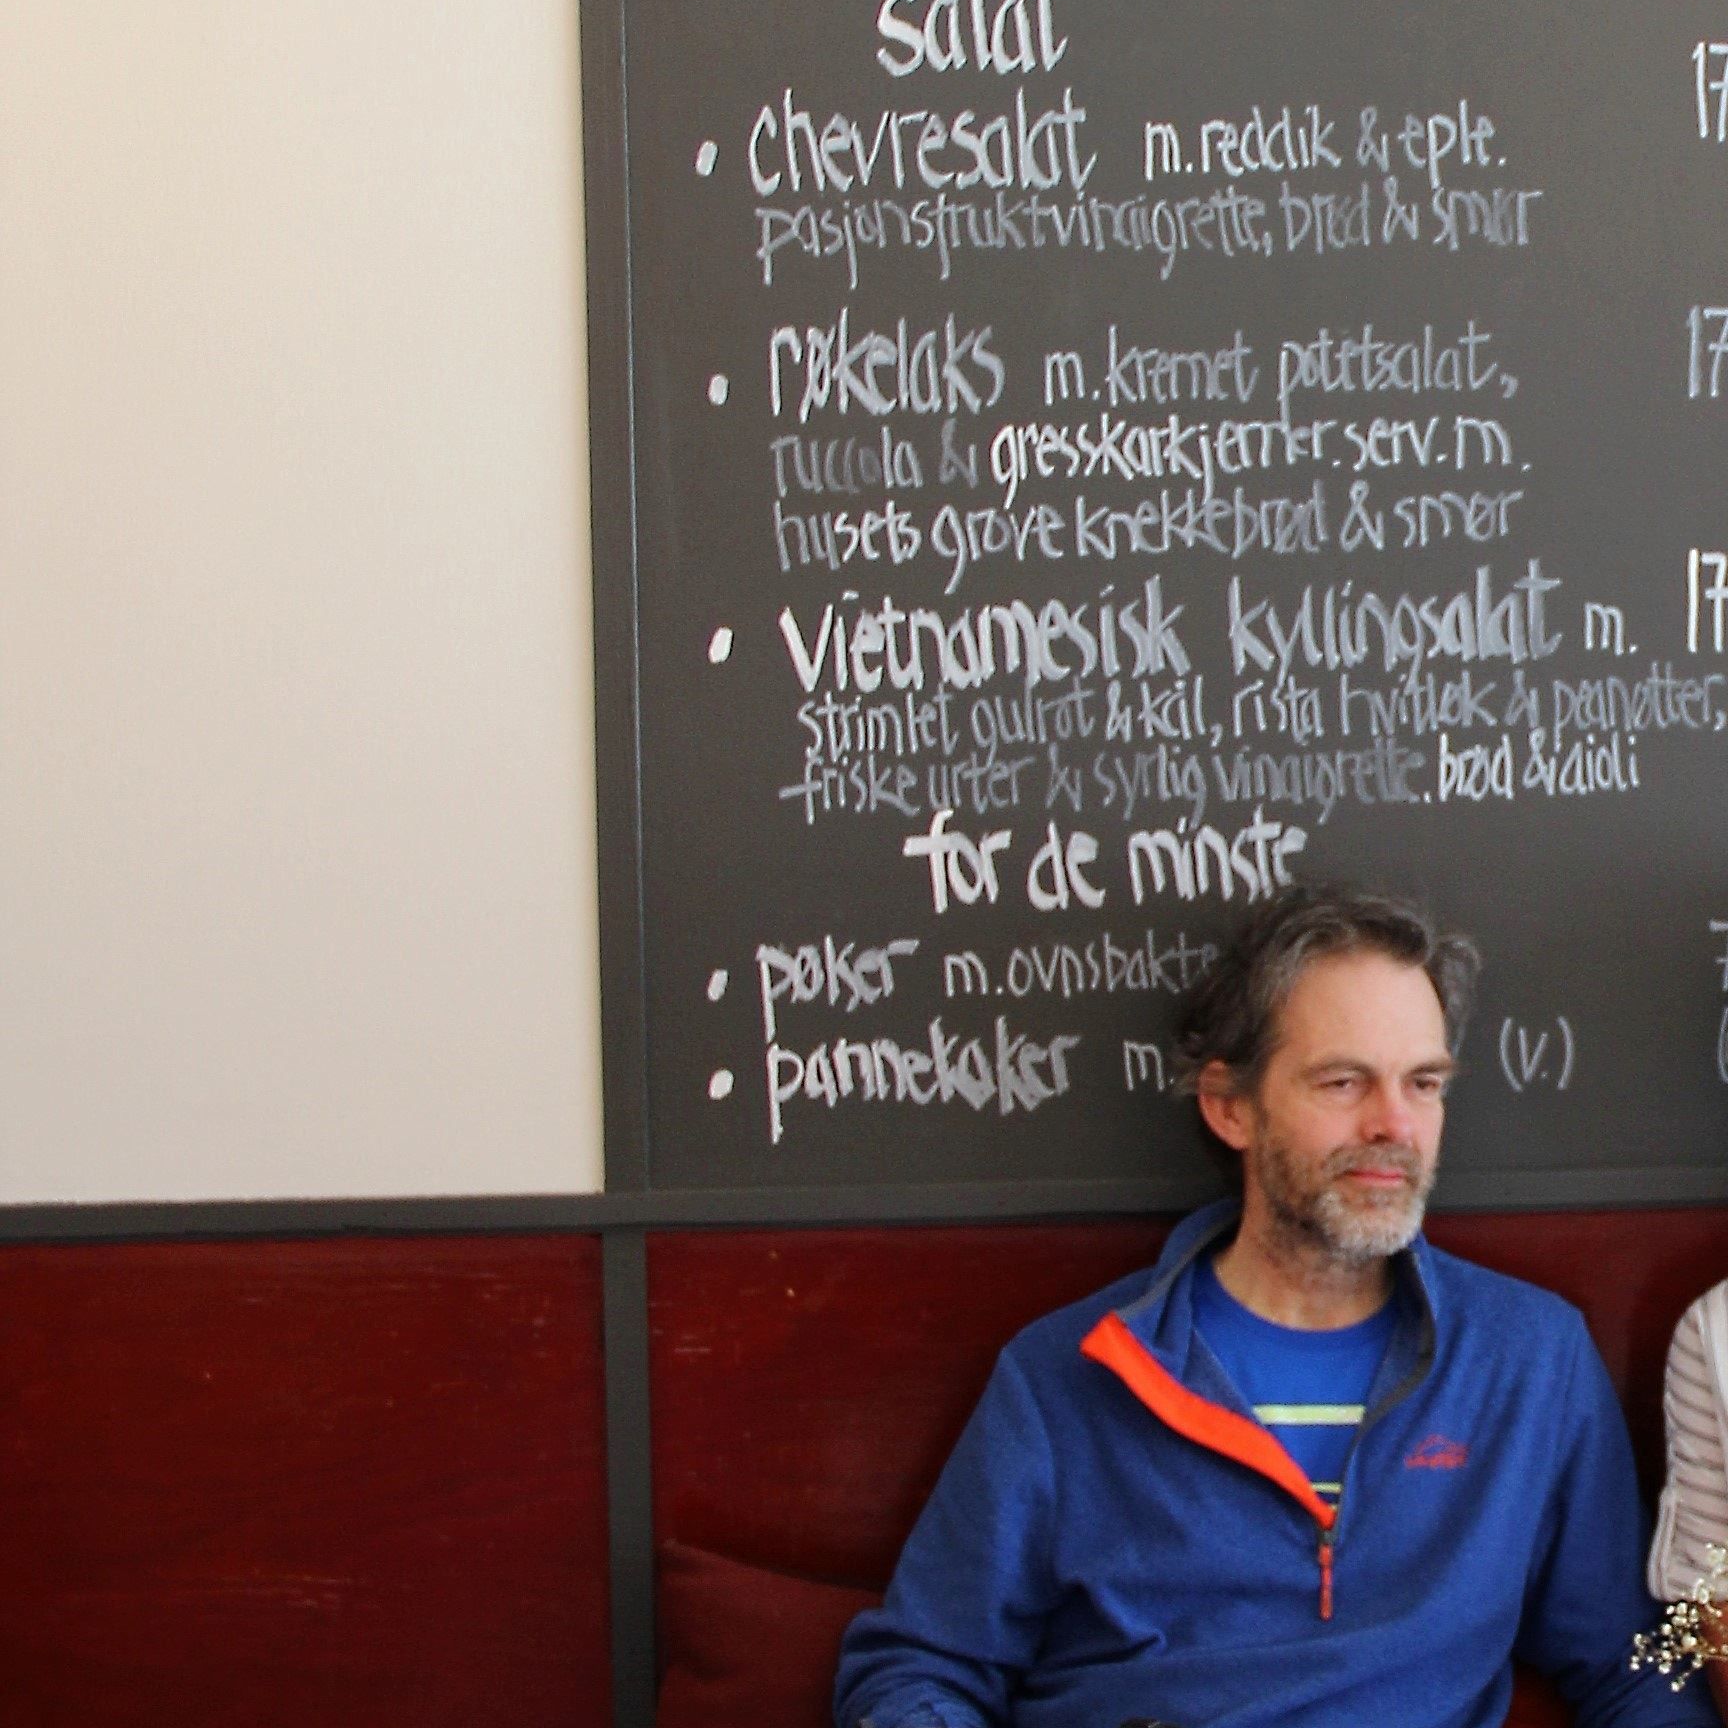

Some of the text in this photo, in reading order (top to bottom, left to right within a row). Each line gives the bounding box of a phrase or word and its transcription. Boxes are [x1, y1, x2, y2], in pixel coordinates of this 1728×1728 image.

[1358, 105, 1389, 172] &
[770, 307, 1003, 424] røkelaks
[773, 501, 920, 572] husets
[931, 505, 1064, 595] grove
[1340, 480, 1384, 552] &
[904, 807, 1307, 914] for de minste
[767, 1017, 1081, 1145] pannekaker
